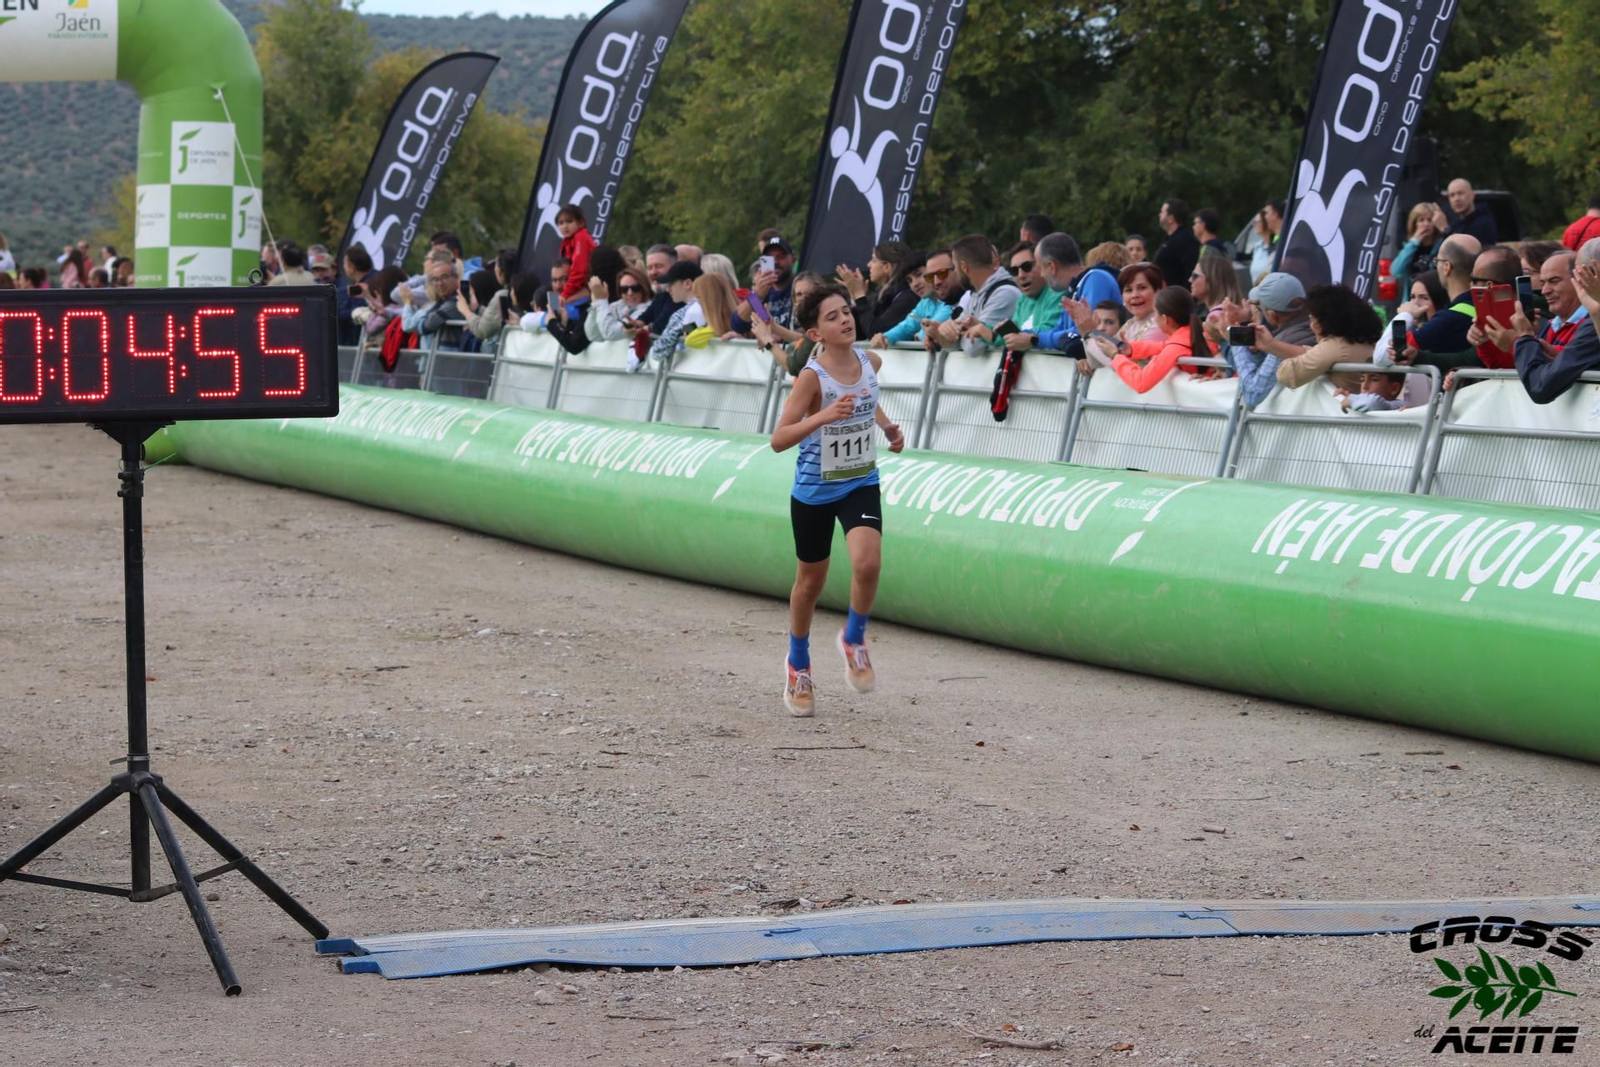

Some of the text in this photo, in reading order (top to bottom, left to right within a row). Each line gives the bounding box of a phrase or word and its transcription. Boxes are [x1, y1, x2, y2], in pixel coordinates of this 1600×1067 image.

[55, 12, 102, 33] Jaén
[177, 211, 228, 221] DEPORTES
[830, 433, 870, 458] 1111
[905, 461, 1124, 531] DIPUTACIÓN
[1251, 499, 1399, 574] JAÉN
